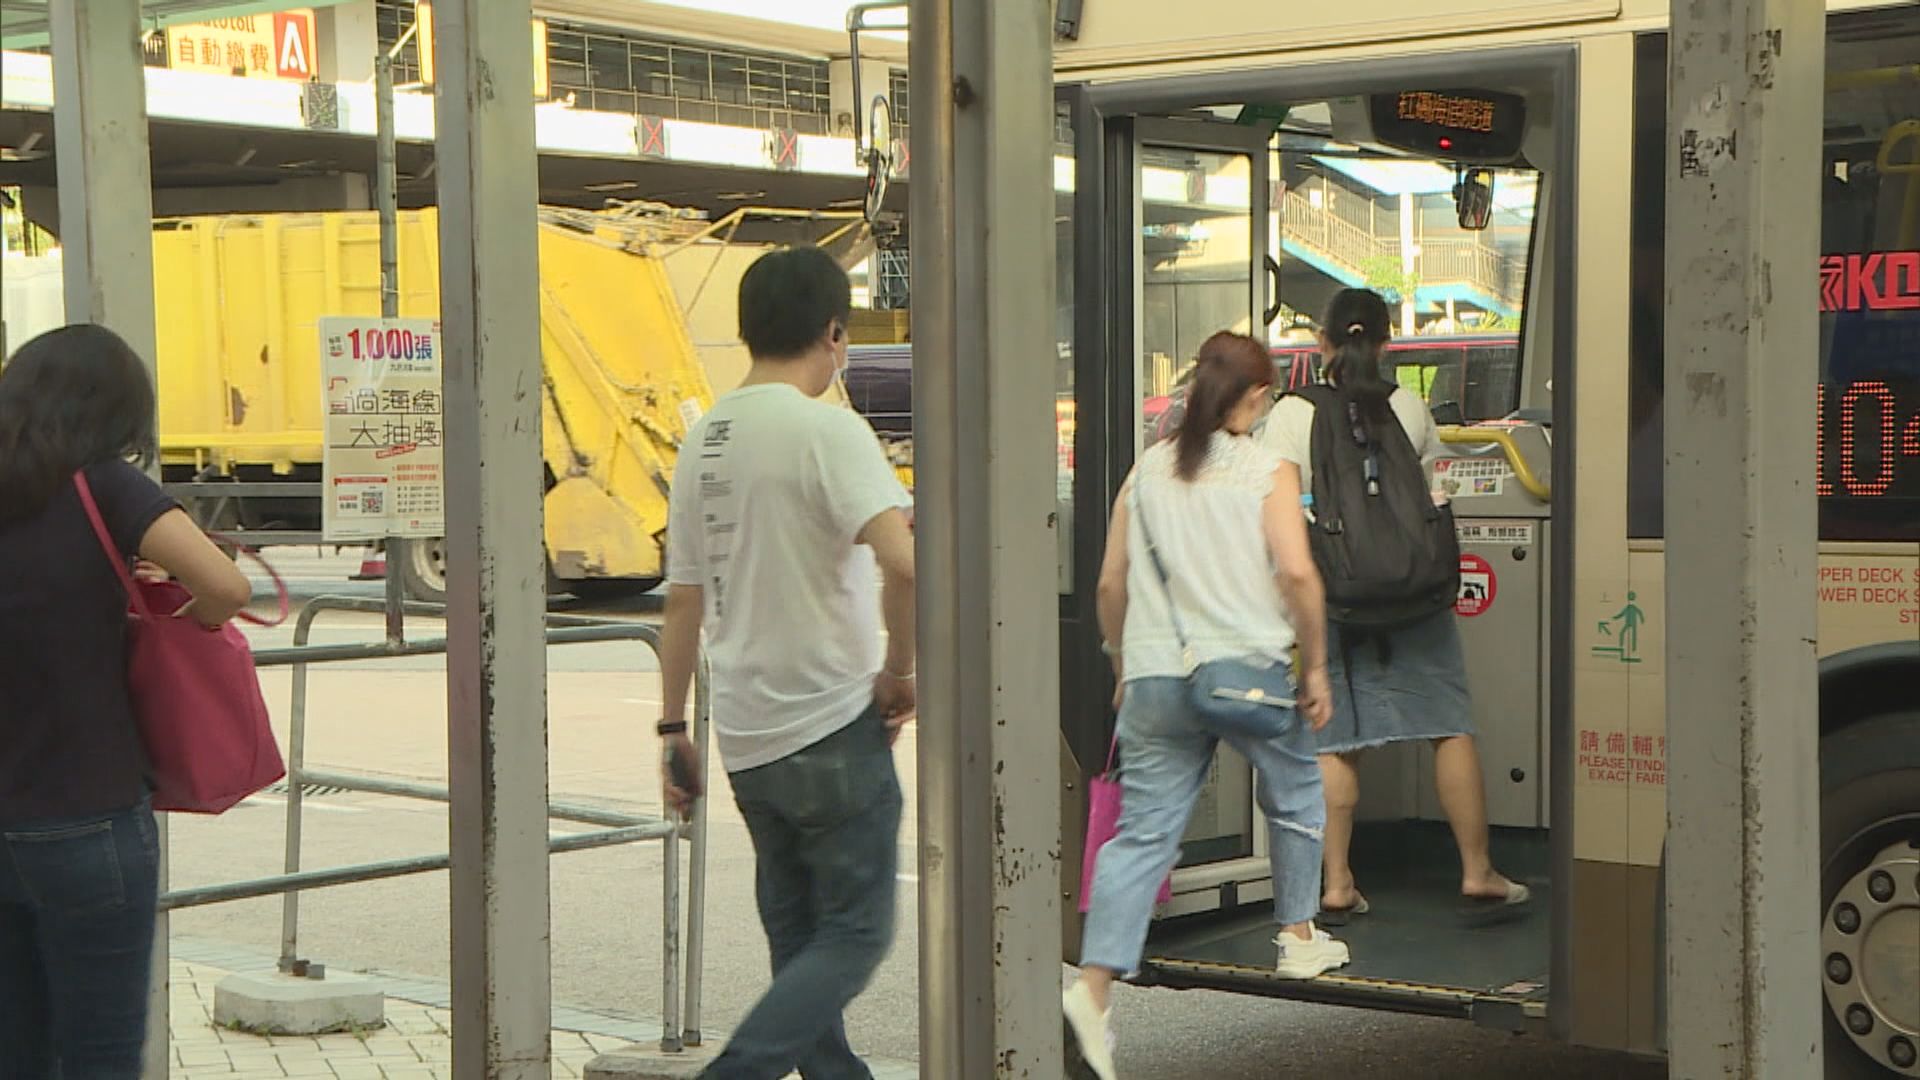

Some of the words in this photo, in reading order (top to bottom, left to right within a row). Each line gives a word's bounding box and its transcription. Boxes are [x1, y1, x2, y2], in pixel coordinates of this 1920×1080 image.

[1818, 567, 1853, 582] PER
[1858, 567, 1904, 583] DECK
[1818, 587, 1857, 603] WER
[1862, 588, 1909, 604] DECK
[1579, 754, 1625, 769] PLEASE
[1628, 758, 1665, 772] TEND
[1588, 767, 1632, 782] EXACT
